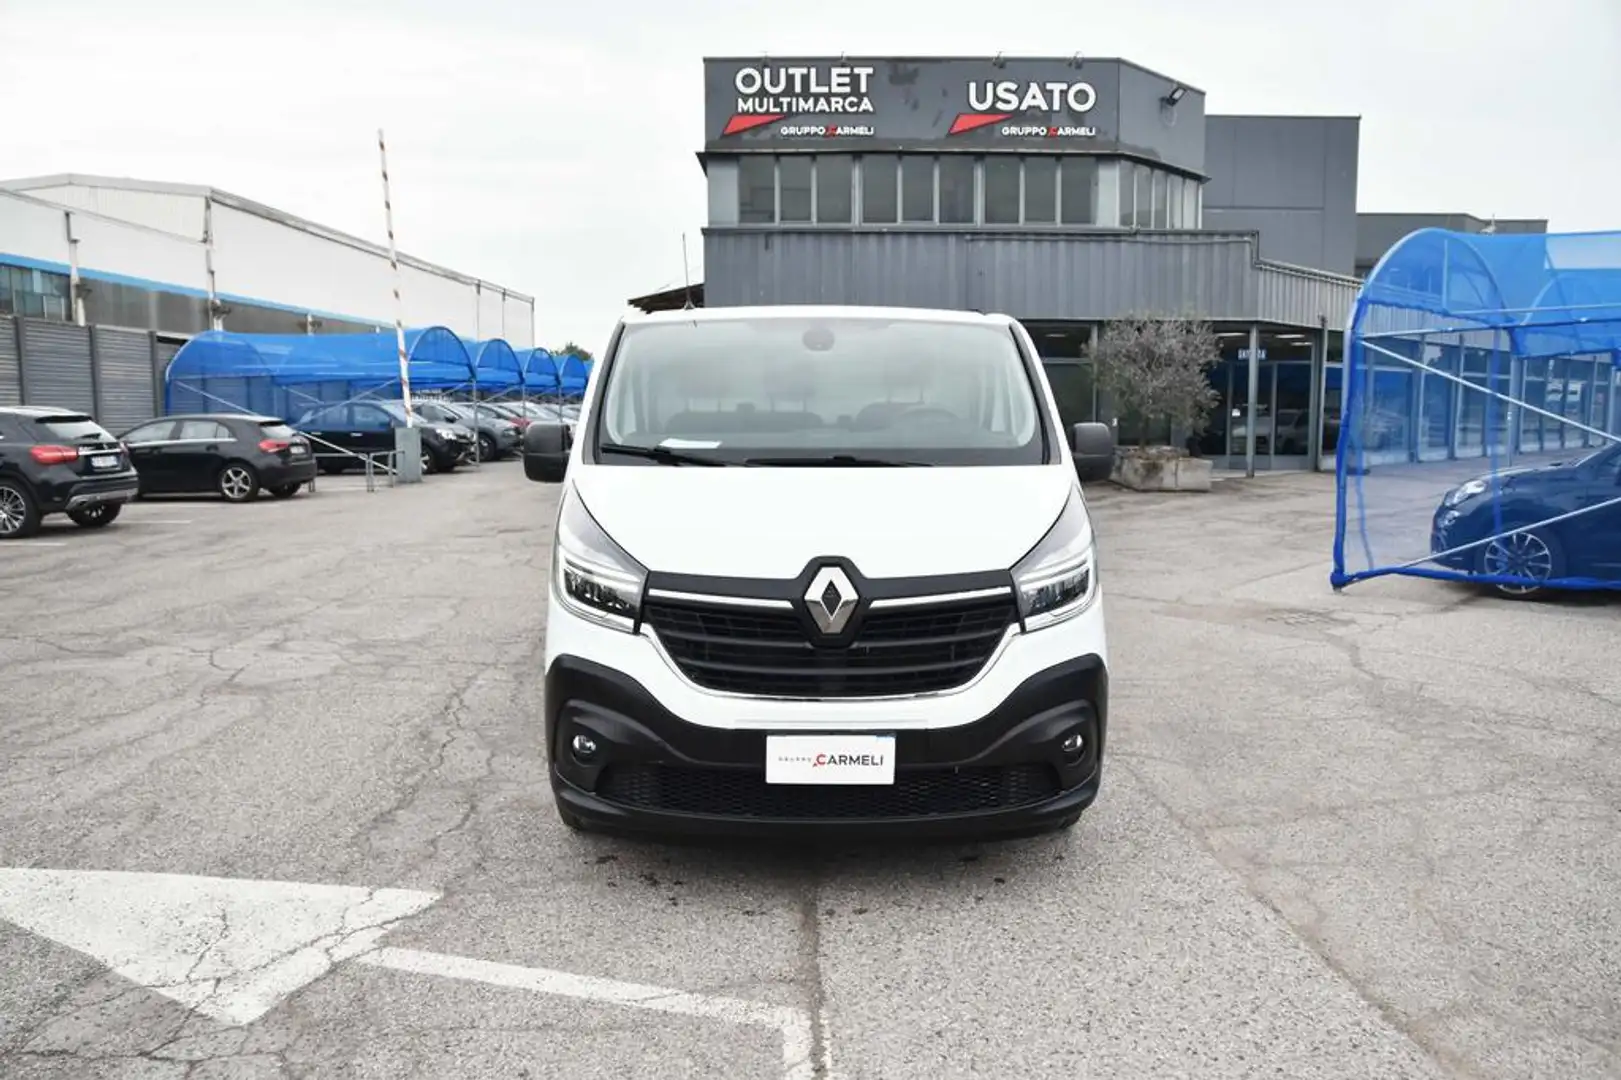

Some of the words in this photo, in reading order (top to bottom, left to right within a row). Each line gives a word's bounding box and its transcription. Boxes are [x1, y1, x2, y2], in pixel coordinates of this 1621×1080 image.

[735, 67, 874, 94] OUTLET
[968, 81, 1097, 112] USATO
[737, 97, 874, 113] MULTIMARCA
[780, 125, 826, 136] GRUPPO
[1001, 126, 1047, 136] GRUPPO
[815, 753, 884, 767] CARMELI
